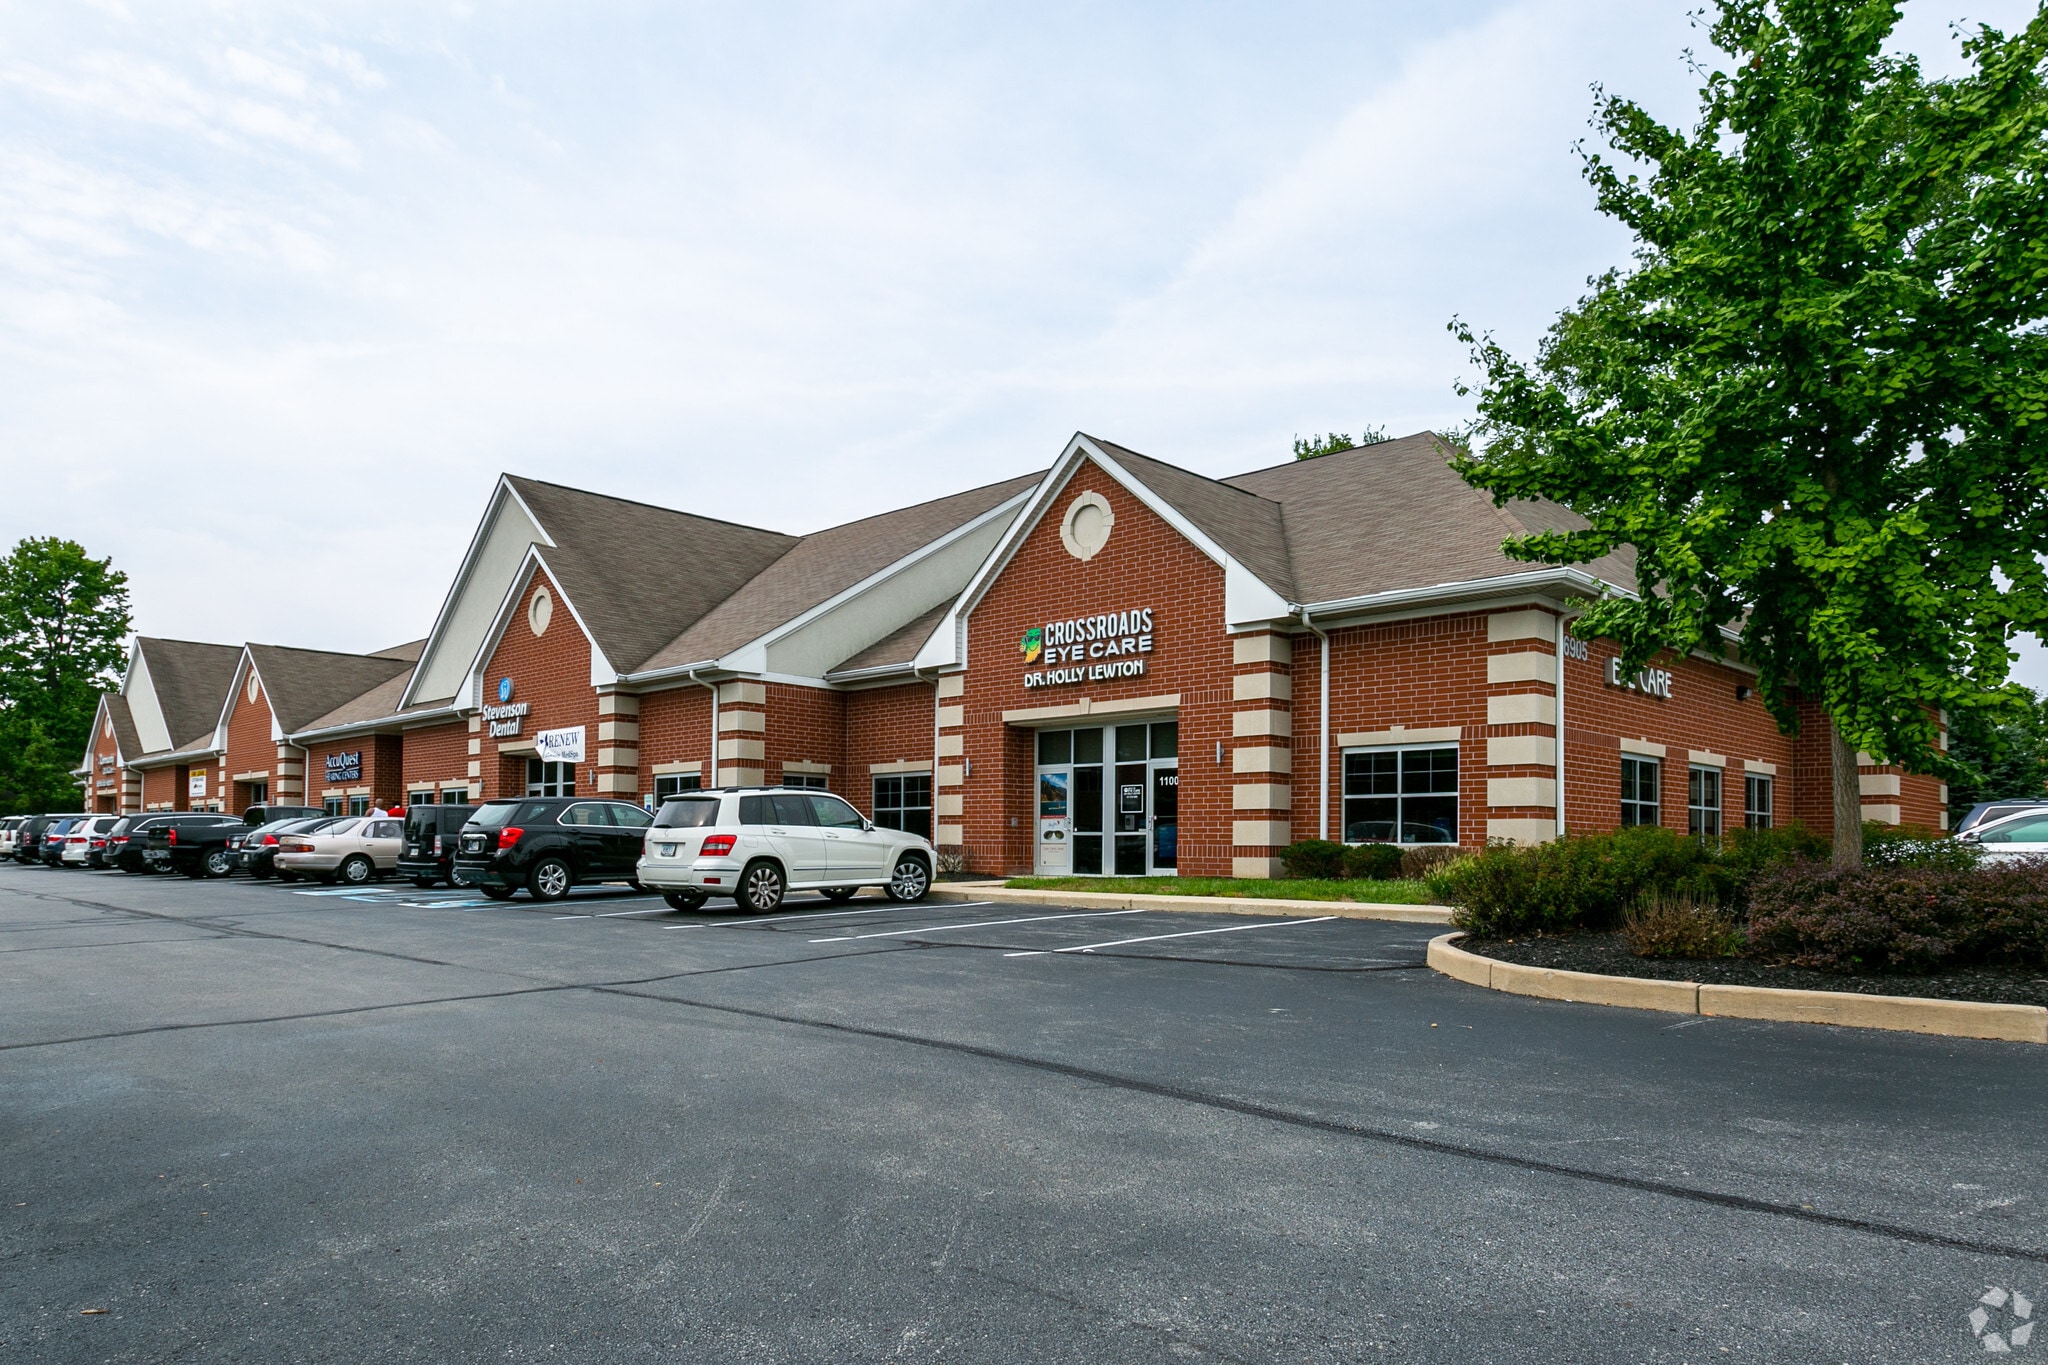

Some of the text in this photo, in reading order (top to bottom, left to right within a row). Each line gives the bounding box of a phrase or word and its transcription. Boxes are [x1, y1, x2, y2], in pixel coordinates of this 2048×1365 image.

[1044, 607, 1153, 646] CROSSROADS
[1044, 635, 1152, 664] EYE CARE
[1563, 635, 1588, 661] 6905
[1024, 659, 1143, 688] DR. HOLLY LEWTON
[1639, 664, 1673, 698] CARE
[482, 702, 527, 721] Stevenson
[489, 717, 519, 737] Dental
[548, 732, 580, 748] RENEW
[326, 751, 359, 769] AccuQuest
[1159, 776, 1179, 786] 1100
